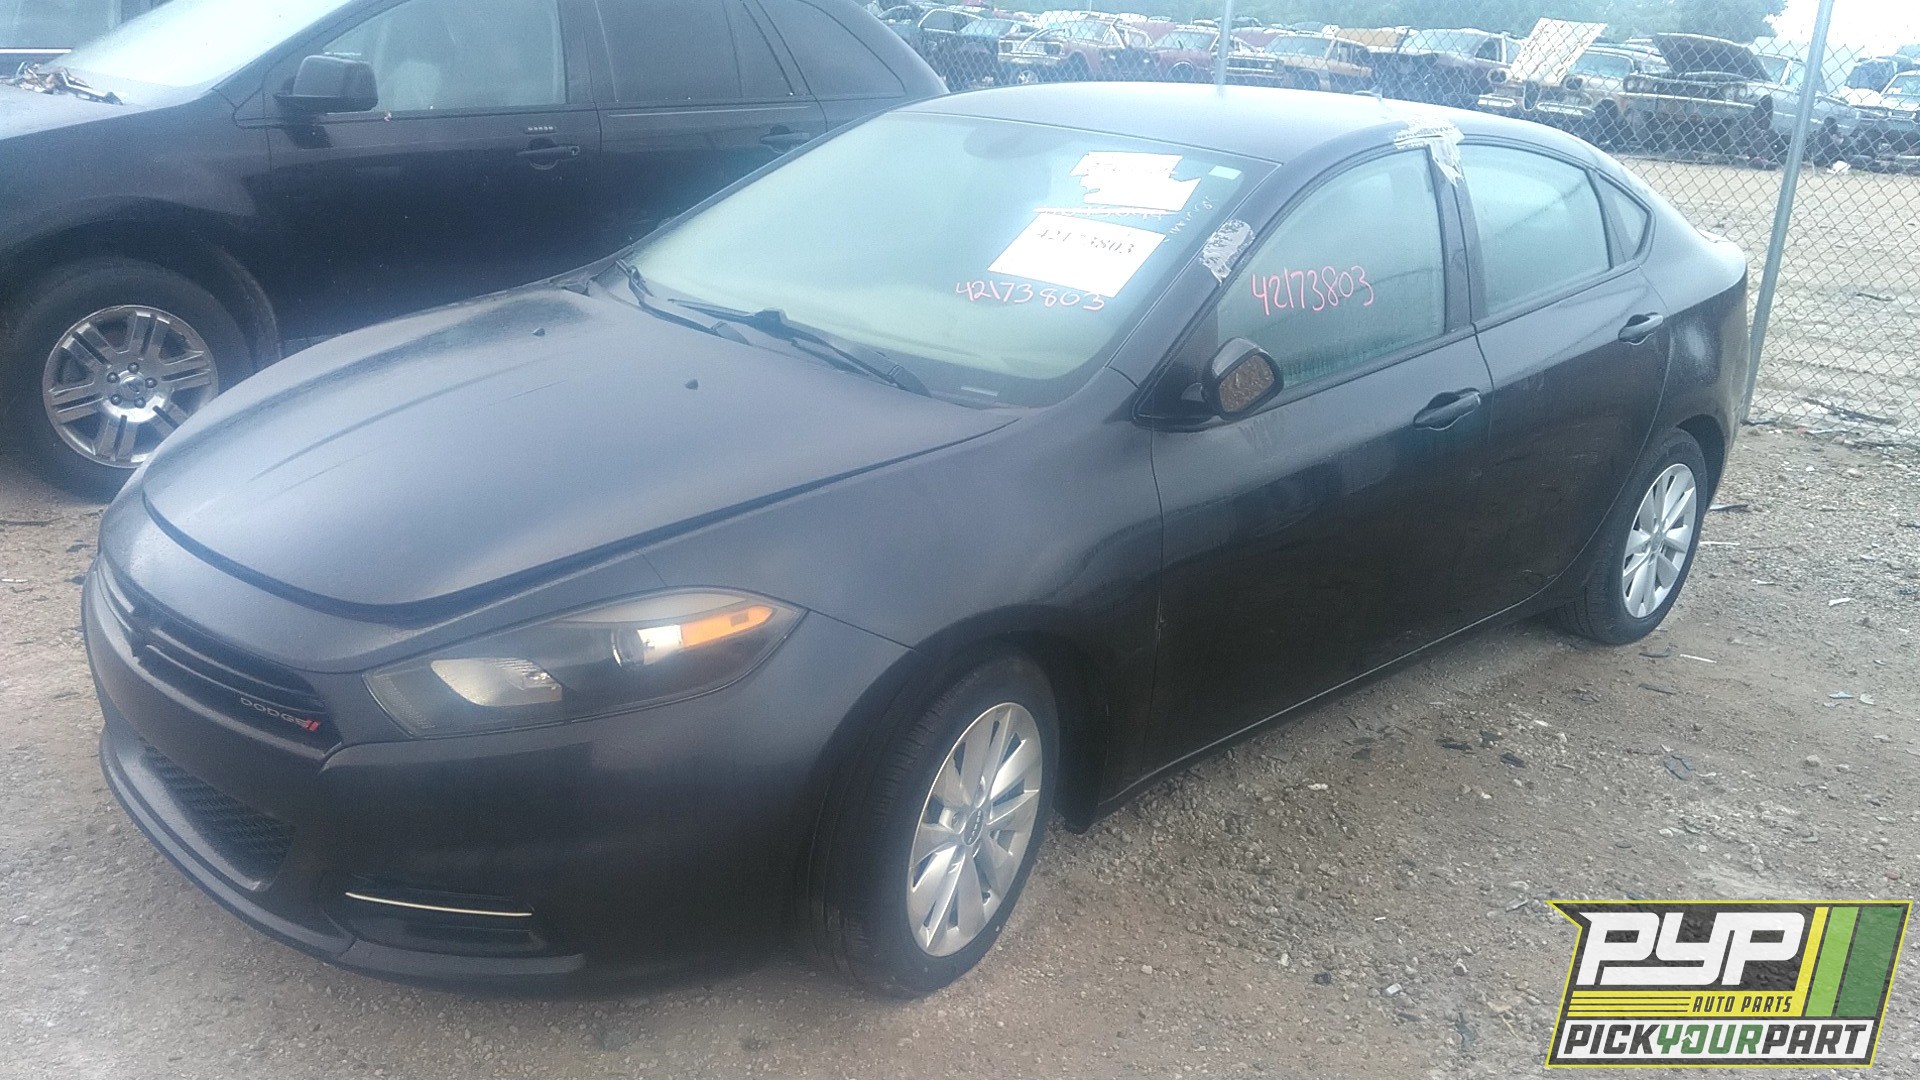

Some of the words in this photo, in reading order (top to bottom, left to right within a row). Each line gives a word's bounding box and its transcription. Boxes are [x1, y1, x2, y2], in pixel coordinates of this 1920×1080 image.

[1036, 227, 1135, 254] 4213803
[955, 280, 1105, 311] 42173803
[1252, 265, 1375, 316] 42173803
[240, 697, 309, 729] DODGE
